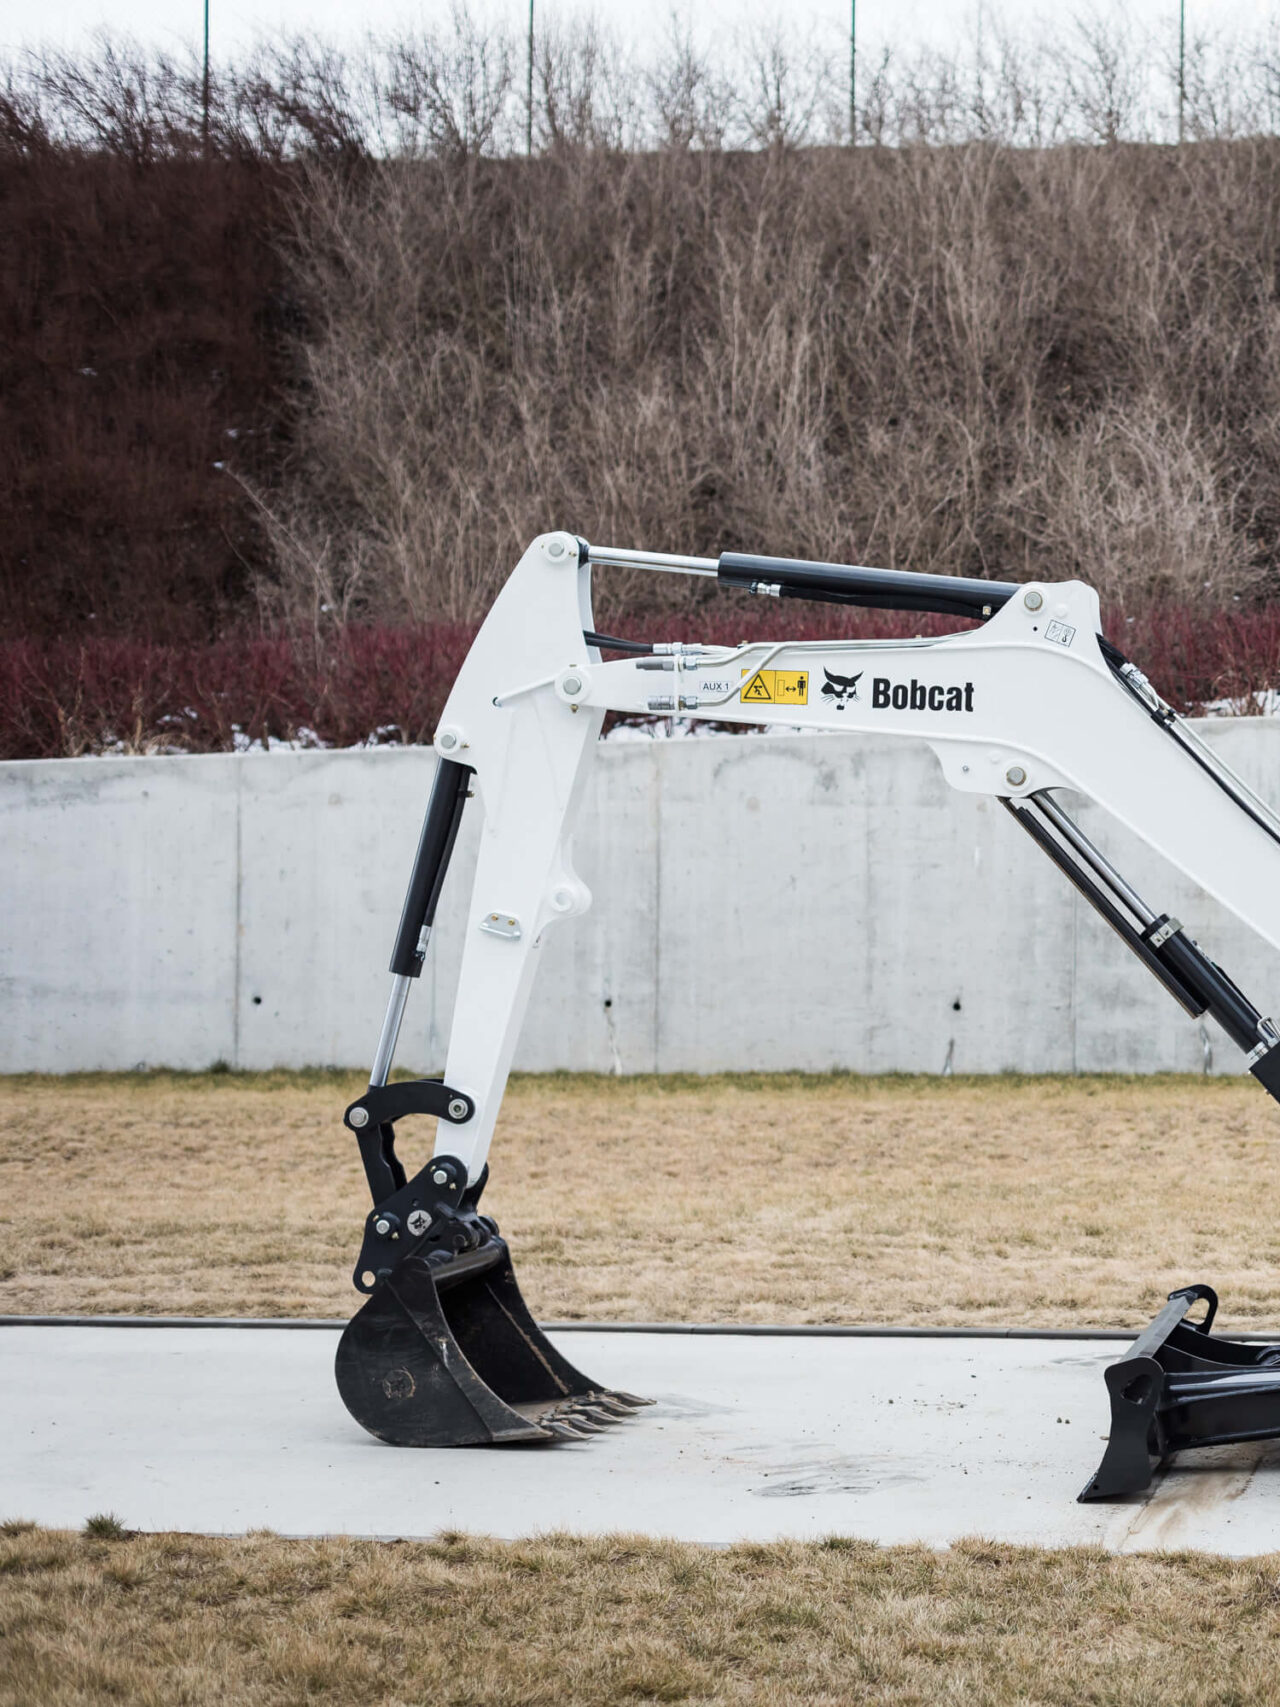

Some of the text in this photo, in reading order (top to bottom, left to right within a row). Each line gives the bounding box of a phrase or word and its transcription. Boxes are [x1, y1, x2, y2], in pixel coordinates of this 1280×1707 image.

[702, 682, 729, 691] AUX 1
[872, 677, 975, 713] Bobcat
